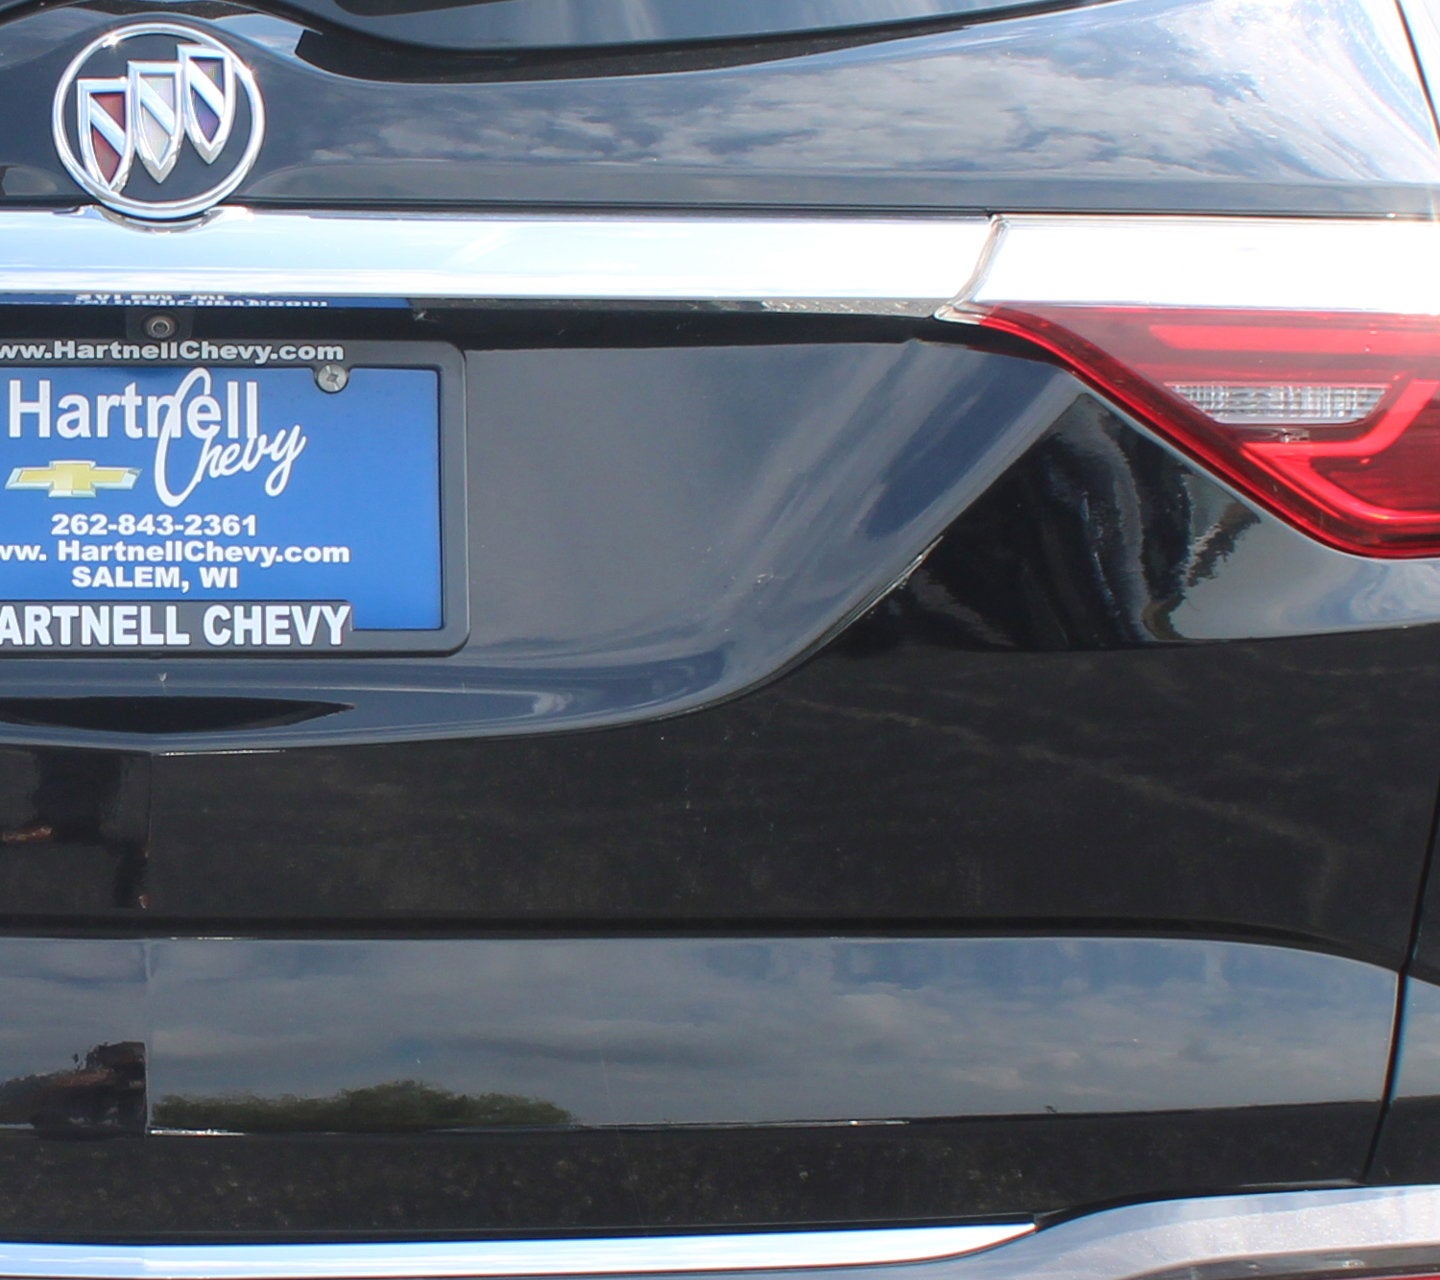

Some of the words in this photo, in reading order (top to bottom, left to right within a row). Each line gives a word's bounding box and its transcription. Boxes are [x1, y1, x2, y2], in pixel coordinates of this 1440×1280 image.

[8, 379, 259, 439] Hartnell
[154, 366, 307, 507] Chevy
[50, 513, 258, 536] 262-843-2361
[57, 540, 351, 567] HartnellChevy.com
[71, 566, 190, 593] SALEM,
[198, 567, 239, 589] WI
[203, 604, 352, 647] CHEVY
